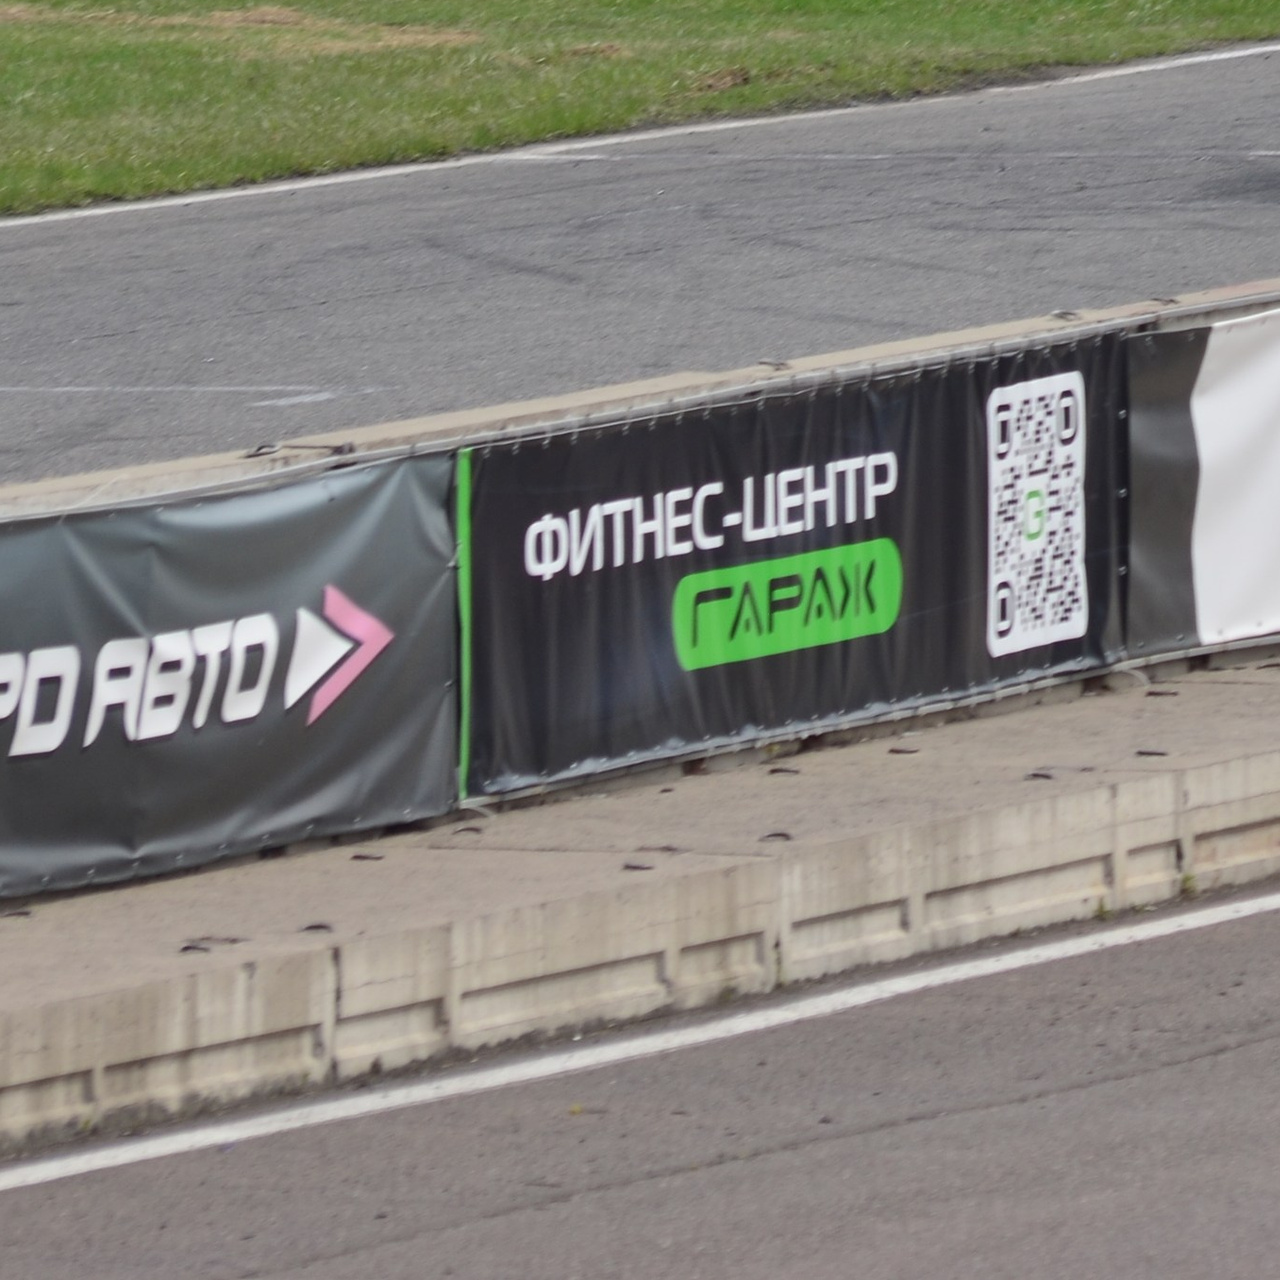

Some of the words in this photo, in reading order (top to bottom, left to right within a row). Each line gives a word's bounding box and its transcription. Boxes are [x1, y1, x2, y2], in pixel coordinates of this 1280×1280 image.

[524, 451, 899, 581] ФИТНЕС-ЦЕНТР
[691, 558, 877, 649] ГАРАЖ
[82, 612, 280, 749] АВТО
